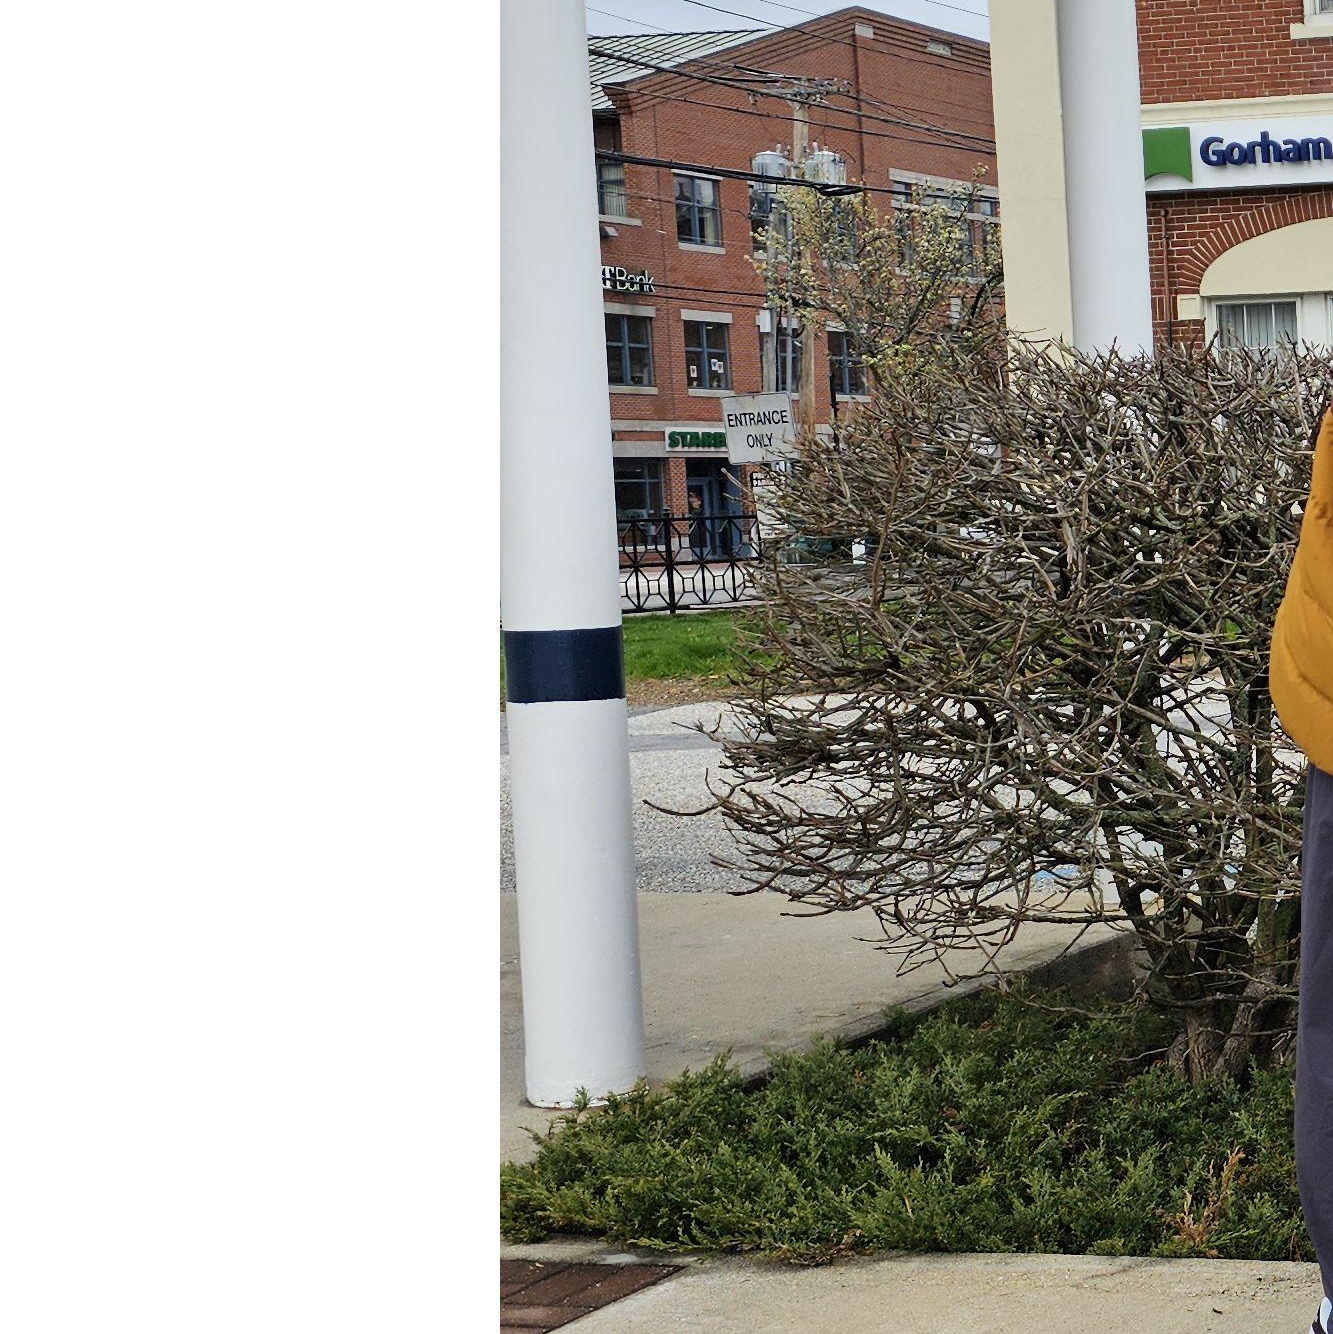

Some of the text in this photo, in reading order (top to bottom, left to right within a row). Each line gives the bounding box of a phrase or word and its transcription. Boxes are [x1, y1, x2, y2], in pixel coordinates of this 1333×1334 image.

[1199, 130, 1333, 167] Gorham
[616, 267, 656, 293] Bank
[727, 410, 789, 428] ENTRANCE
[746, 432, 774, 449] ONLY
